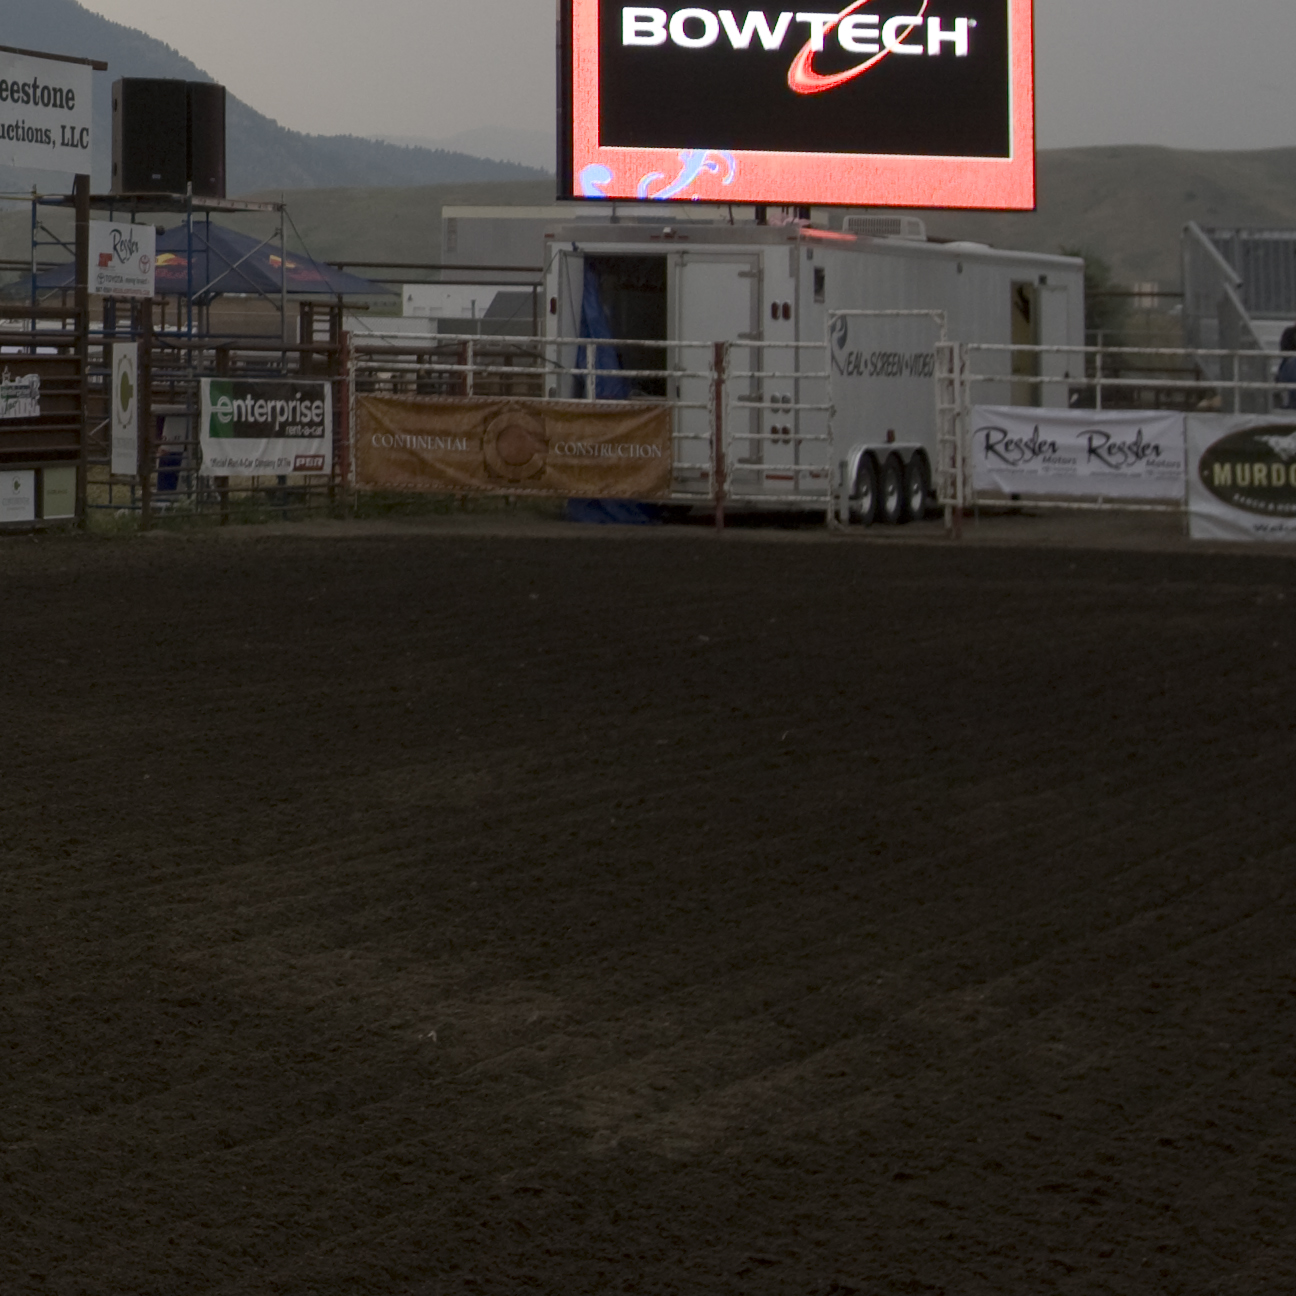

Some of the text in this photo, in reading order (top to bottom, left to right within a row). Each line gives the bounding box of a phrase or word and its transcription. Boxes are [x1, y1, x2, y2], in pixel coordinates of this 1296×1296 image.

[621, 5, 970, 57] BOWTECH
[60, 125, 89, 150] LLC
[216, 392, 325, 431] enterprise
[286, 425, 325, 437] rent-a-car
[371, 433, 662, 459] CONTINENTAL CONSTRUCTION
[975, 424, 1162, 470] Ressler Ressler
[1041, 455, 1077, 465] Motors
